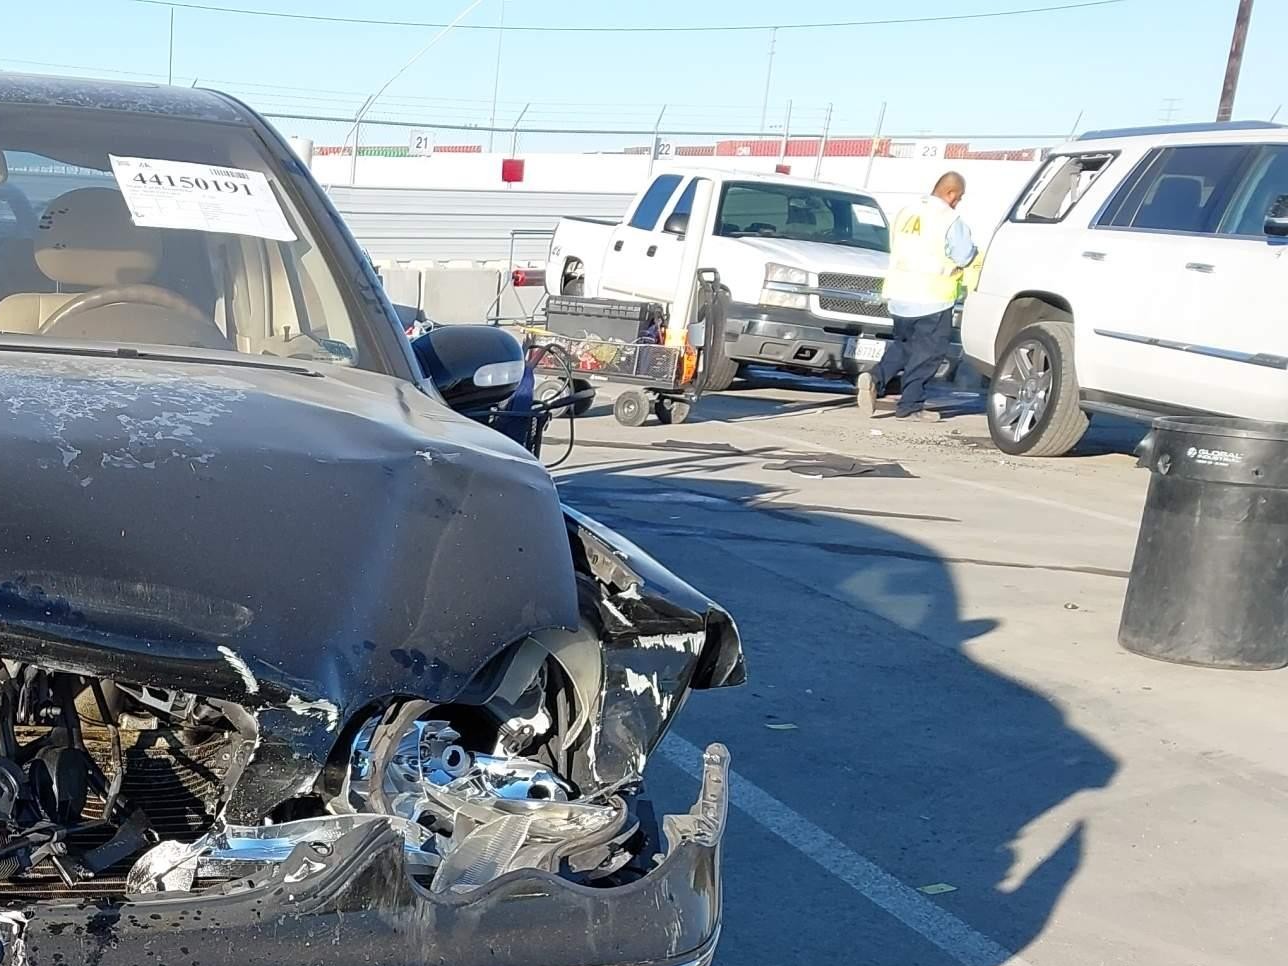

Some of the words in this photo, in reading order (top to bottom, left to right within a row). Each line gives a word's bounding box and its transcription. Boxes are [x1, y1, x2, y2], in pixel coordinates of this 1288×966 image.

[416, 136, 428, 149] 21
[659, 143, 671, 155] 22
[922, 145, 938, 157] 23
[133, 172, 254, 196] 44150191
[1198, 448, 1243, 460] GLOBAL
